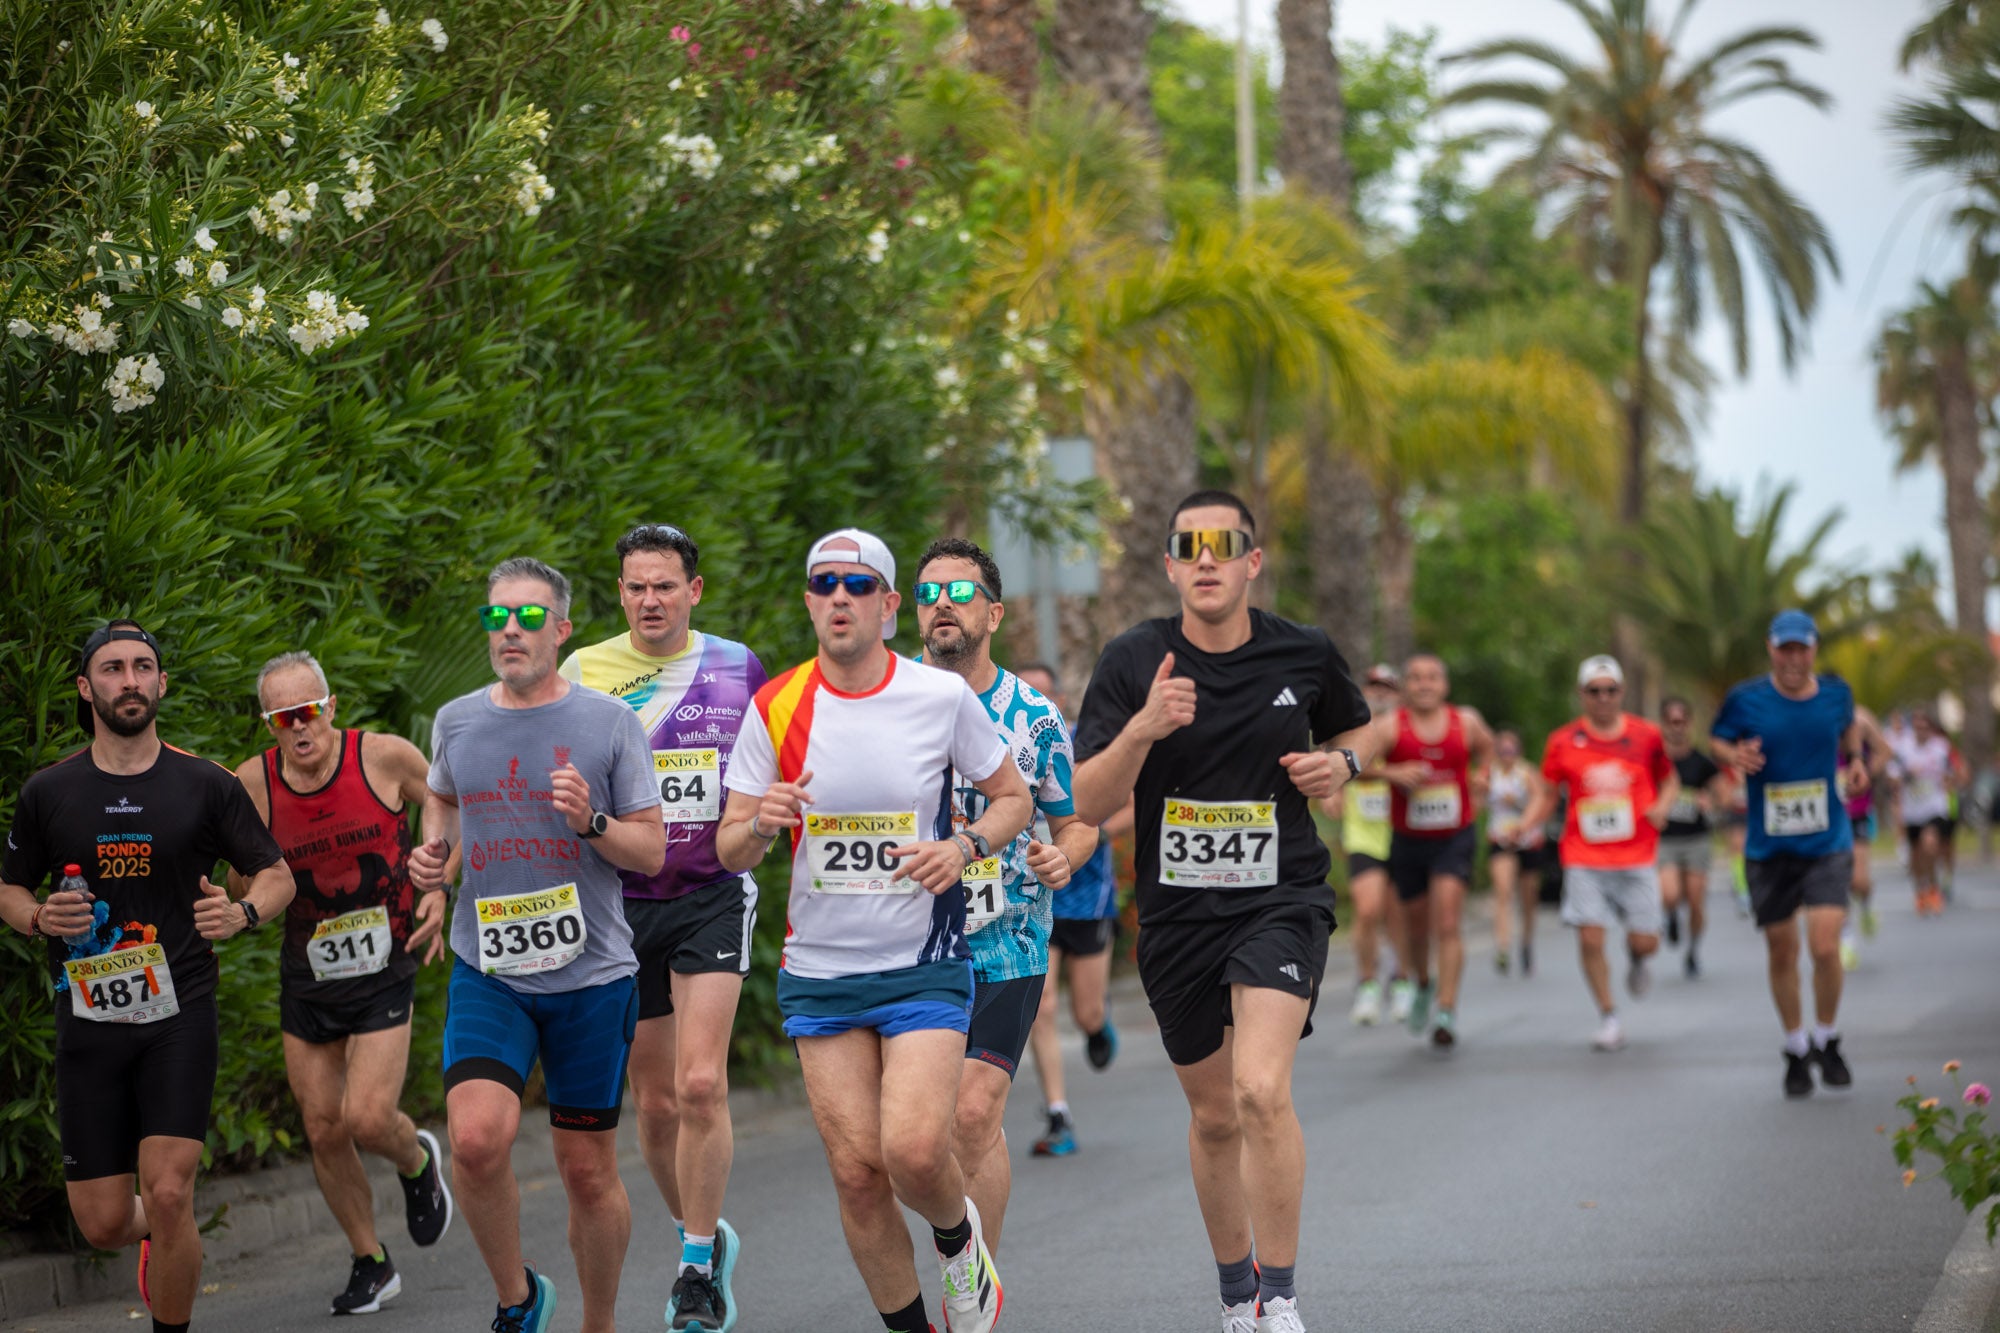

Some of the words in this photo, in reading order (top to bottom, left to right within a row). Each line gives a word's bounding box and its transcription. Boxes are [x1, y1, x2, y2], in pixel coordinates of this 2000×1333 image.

[658, 757, 699, 768] ONDO
[497, 778, 528, 790] XXVI
[661, 775, 706, 803] 64
[462, 791, 503, 808] PRUEBA
[509, 791, 523, 802] DE
[104, 806, 144, 814] TEAMERGY
[1178, 806, 1195, 822] 38
[1195, 812, 1253, 823] FONDO
[682, 823, 704, 831] NEMO
[821, 818, 838, 831] 38
[838, 820, 894, 832] FONDO
[96, 834, 120, 843] GRAN
[121, 833, 153, 842] PREMIO
[335, 823, 382, 848] RUNNING
[97, 843, 152, 858] FONDO
[823, 841, 901, 872] 290
[1165, 831, 1273, 865] 3347
[99, 857, 151, 879] 2025
[489, 902, 503, 917] 38
[503, 898, 556, 917] FONDO
[483, 914, 581, 958] 3360
[320, 931, 375, 963] 311
[78, 962, 93, 976] 38
[93, 955, 144, 975] FONDO
[91, 973, 152, 1011] 487
